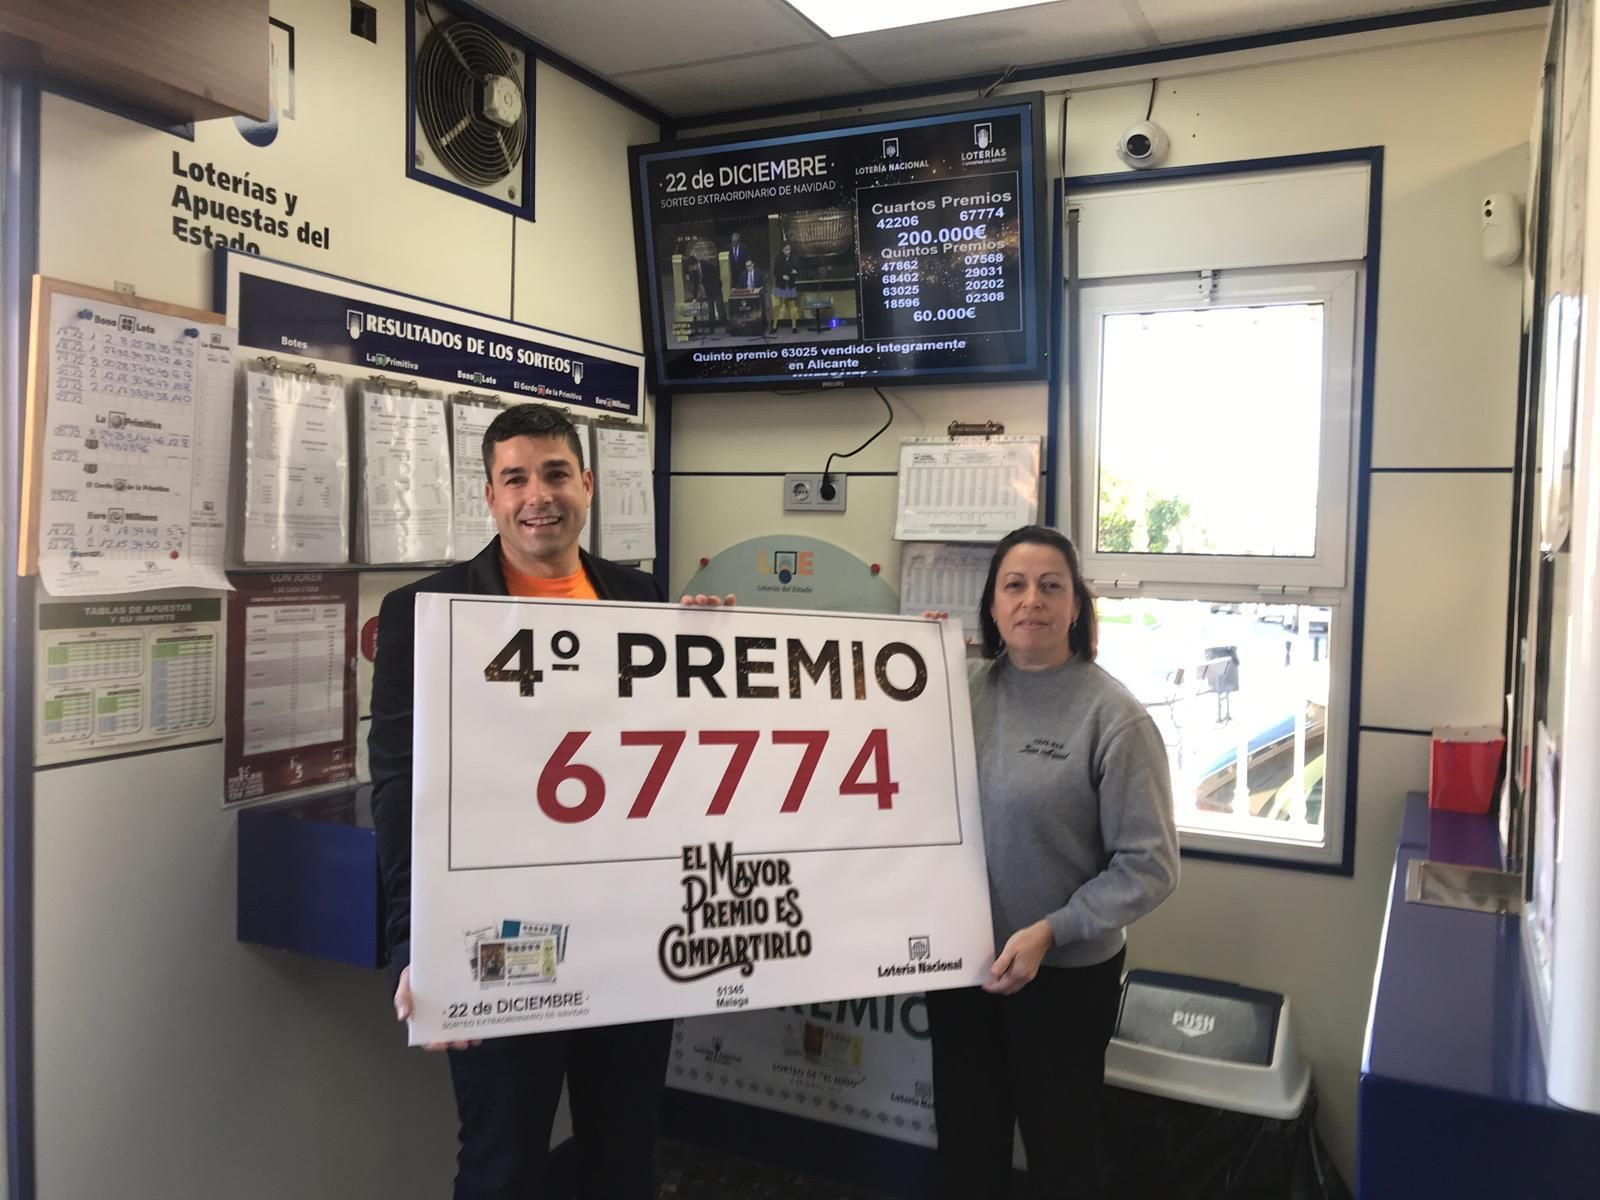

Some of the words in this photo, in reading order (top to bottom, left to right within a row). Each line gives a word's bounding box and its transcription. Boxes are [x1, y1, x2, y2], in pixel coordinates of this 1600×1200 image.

[961, 147, 1007, 161] LOTERÍAS
[665, 172, 687, 193] 22
[691, 169, 715, 190] de
[719, 154, 828, 187] DICIEMBRE
[888, 160, 929, 172] NACIONAL
[172, 150, 277, 205] Loterías
[284, 192, 298, 216] y
[660, 196, 695, 209] SORTEO
[697, 187, 777, 205] EXTRAORDINARIO
[778, 185, 791, 195] DE
[794, 180, 836, 194] NAVIDAD
[872, 200, 936, 215] Cuartos
[941, 192, 1012, 208] Premios
[171, 184, 289, 238] Apuestas
[296, 221, 329, 250] del
[876, 215, 919, 229] 42206
[959, 207, 1005, 221] 67774
[897, 225, 987, 246] 200.000€
[881, 247, 938, 259] Quintos
[943, 240, 1005, 253] Premios
[881, 260, 919, 272] 47862
[964, 253, 1004, 265] 07568
[882, 273, 919, 284] 68402
[965, 266, 1003, 278] 29031
[882, 285, 919, 296] 63025
[965, 279, 1004, 291] 20202
[883, 298, 920, 309] 18596
[965, 292, 1005, 303] 02308
[913, 307, 977, 322] 60.000€
[94, 315, 116, 327] Bono
[136, 323, 155, 334] Loto
[281, 335, 308, 349] Botes
[366, 314, 462, 350] RESULTADOS
[467, 337, 485, 355] DE
[489, 342, 514, 361] LOS
[517, 349, 570, 374] SORTEOS
[366, 352, 376, 362] La
[386, 357, 419, 371] Primitiva
[693, 352, 732, 362] Quinto
[736, 349, 778, 362] premio
[781, 347, 817, 358] 63025
[820, 344, 872, 356] vendido
[788, 361, 804, 370] en
[806, 358, 860, 369] Alicante
[457, 370, 474, 381] Bono
[482, 374, 497, 385] Loto
[513, 381, 519, 389] El
[520, 383, 538, 393] Gordo
[545, 387, 552, 395] de
[552, 389, 558, 397] la
[558, 390, 583, 401] Primitiva
[96, 414, 106, 423] La
[124, 418, 162, 429] Primitiva
[87, 538, 94, 547] 2
[85, 606, 127, 615] TABLAS
[128, 606, 142, 614] DE
[144, 604, 192, 613] APUESTAS
[119, 615, 133, 623] SU
[484, 628, 580, 698] 4º
[617, 632, 929, 702] PREMIO
[536, 728, 899, 824] 67774
[682, 845, 707, 871] EL
[775, 888, 803, 928] ES
[918, 957, 962, 974] Nacional
[448, 1003, 468, 1019] 22
[472, 1000, 492, 1016] de
[497, 992, 584, 1014] DICIEMBRE
[442, 1019, 475, 1030] SORTEO
[556, 1008, 590, 1019] NAVIDAD
[1171, 1010, 1216, 1033] PUSH
